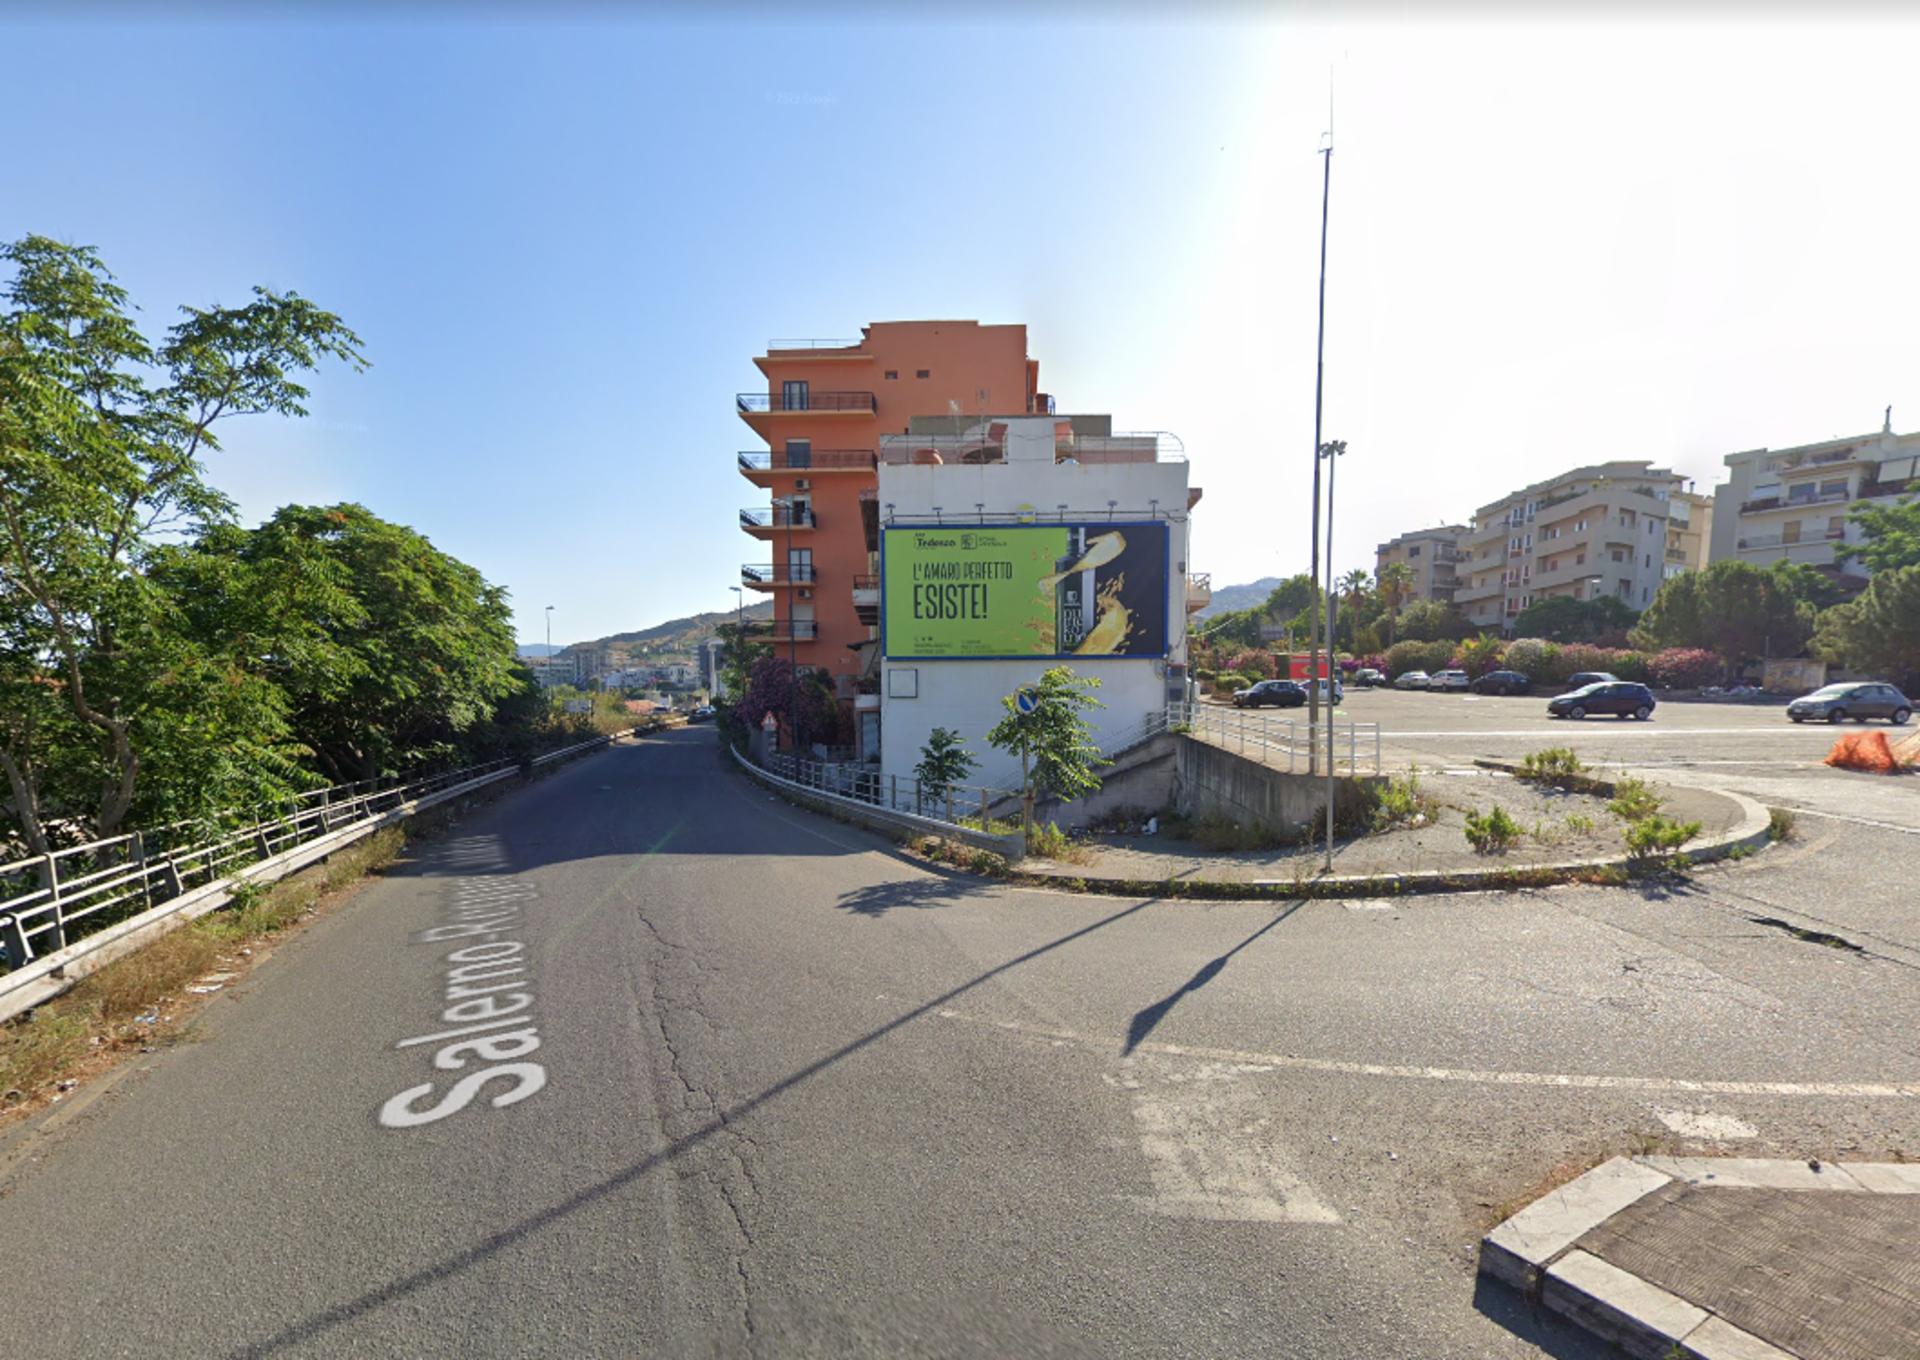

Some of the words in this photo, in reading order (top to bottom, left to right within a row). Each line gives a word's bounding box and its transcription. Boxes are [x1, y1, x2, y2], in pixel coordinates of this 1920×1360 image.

[913, 561, 960, 581] L'AMARO
[963, 561, 1013, 580] PERFETTO
[913, 583, 987, 619] ESISTE!
